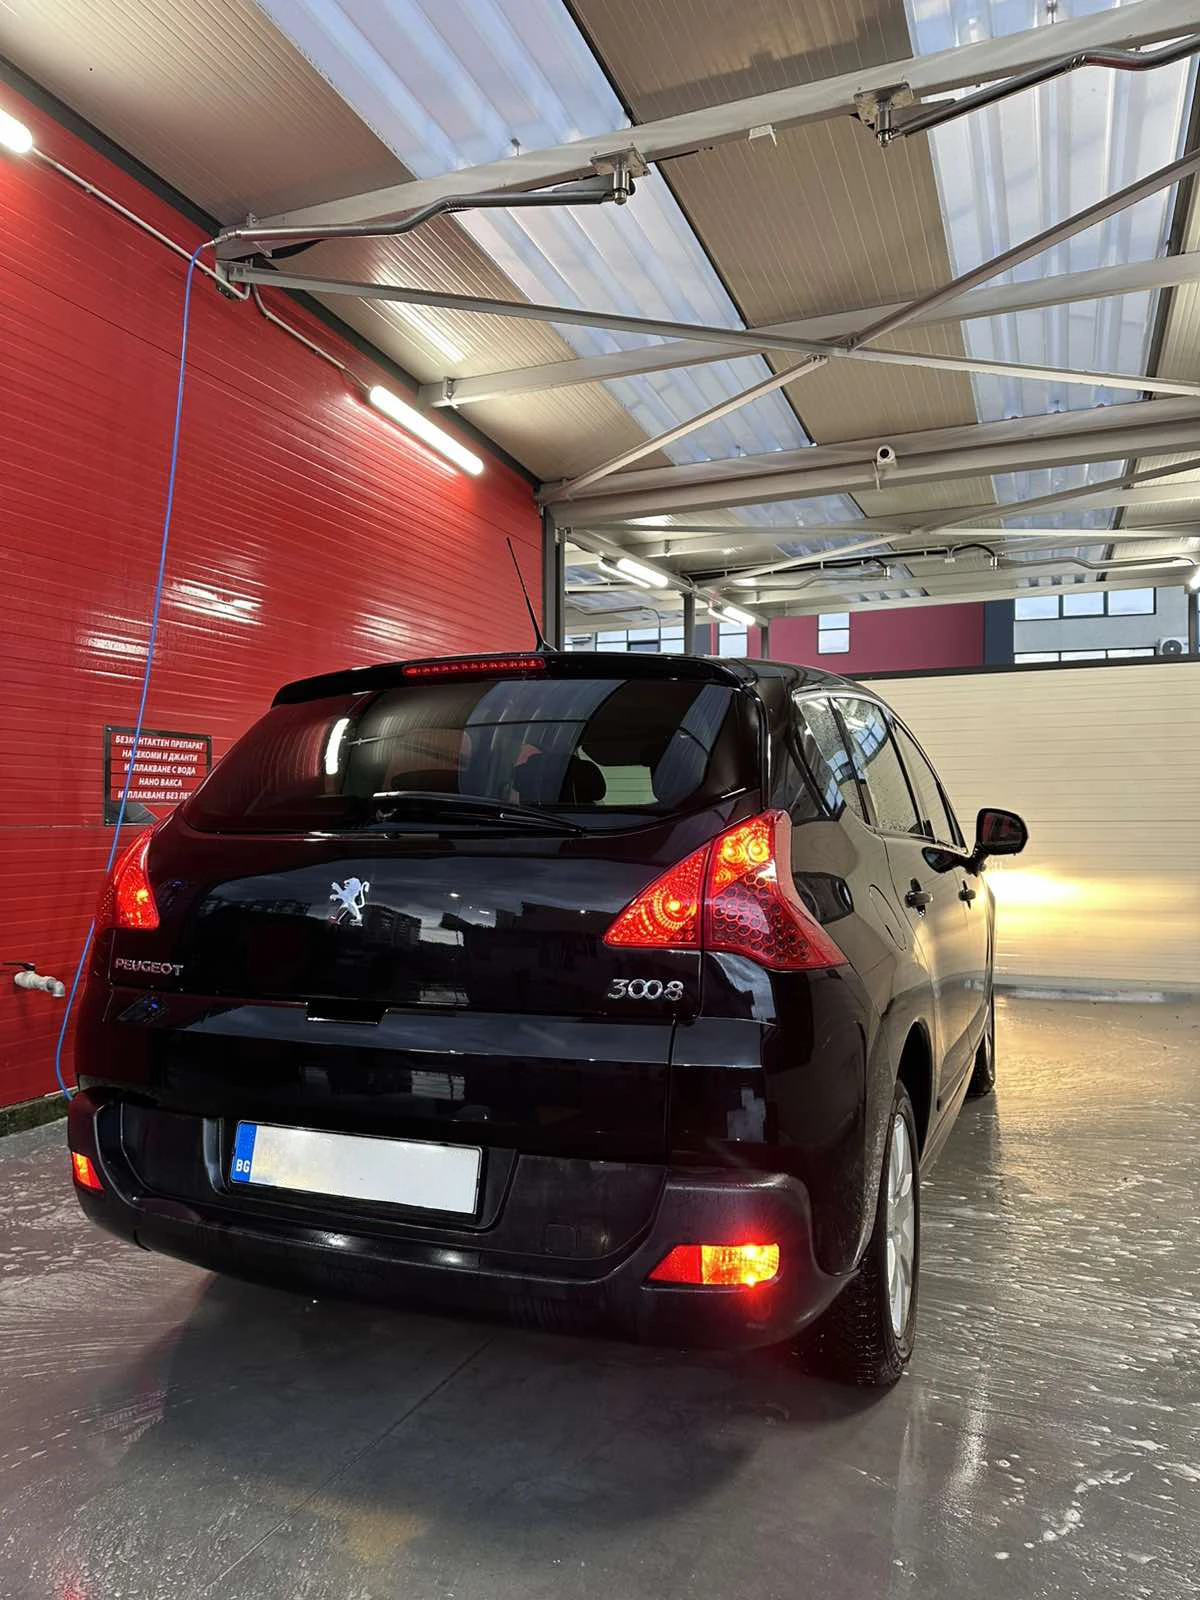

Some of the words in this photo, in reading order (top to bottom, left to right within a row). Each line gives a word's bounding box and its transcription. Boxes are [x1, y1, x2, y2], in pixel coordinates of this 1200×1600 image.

[115, 735, 170, 747] БЕЗКНТАКТЕН
[170, 739, 204, 750] ПРЕПАРАТ
[162, 752, 169, 760] И
[168, 753, 198, 762] ДЖАНТИ
[124, 763, 171, 774] ИПЛАКВАНЕ
[171, 766, 177, 774] С
[177, 766, 196, 776] ВОДА
[138, 777, 160, 786] НАНО
[160, 778, 183, 788] ВАКСА
[117, 790, 165, 800] ИПЛАКВАНЕ
[165, 791, 179, 800] БЕЗ
[115, 957, 184, 976] PEUGEOT
[607, 978, 684, 1001] 3008
[235, 1158, 251, 1173] BG
